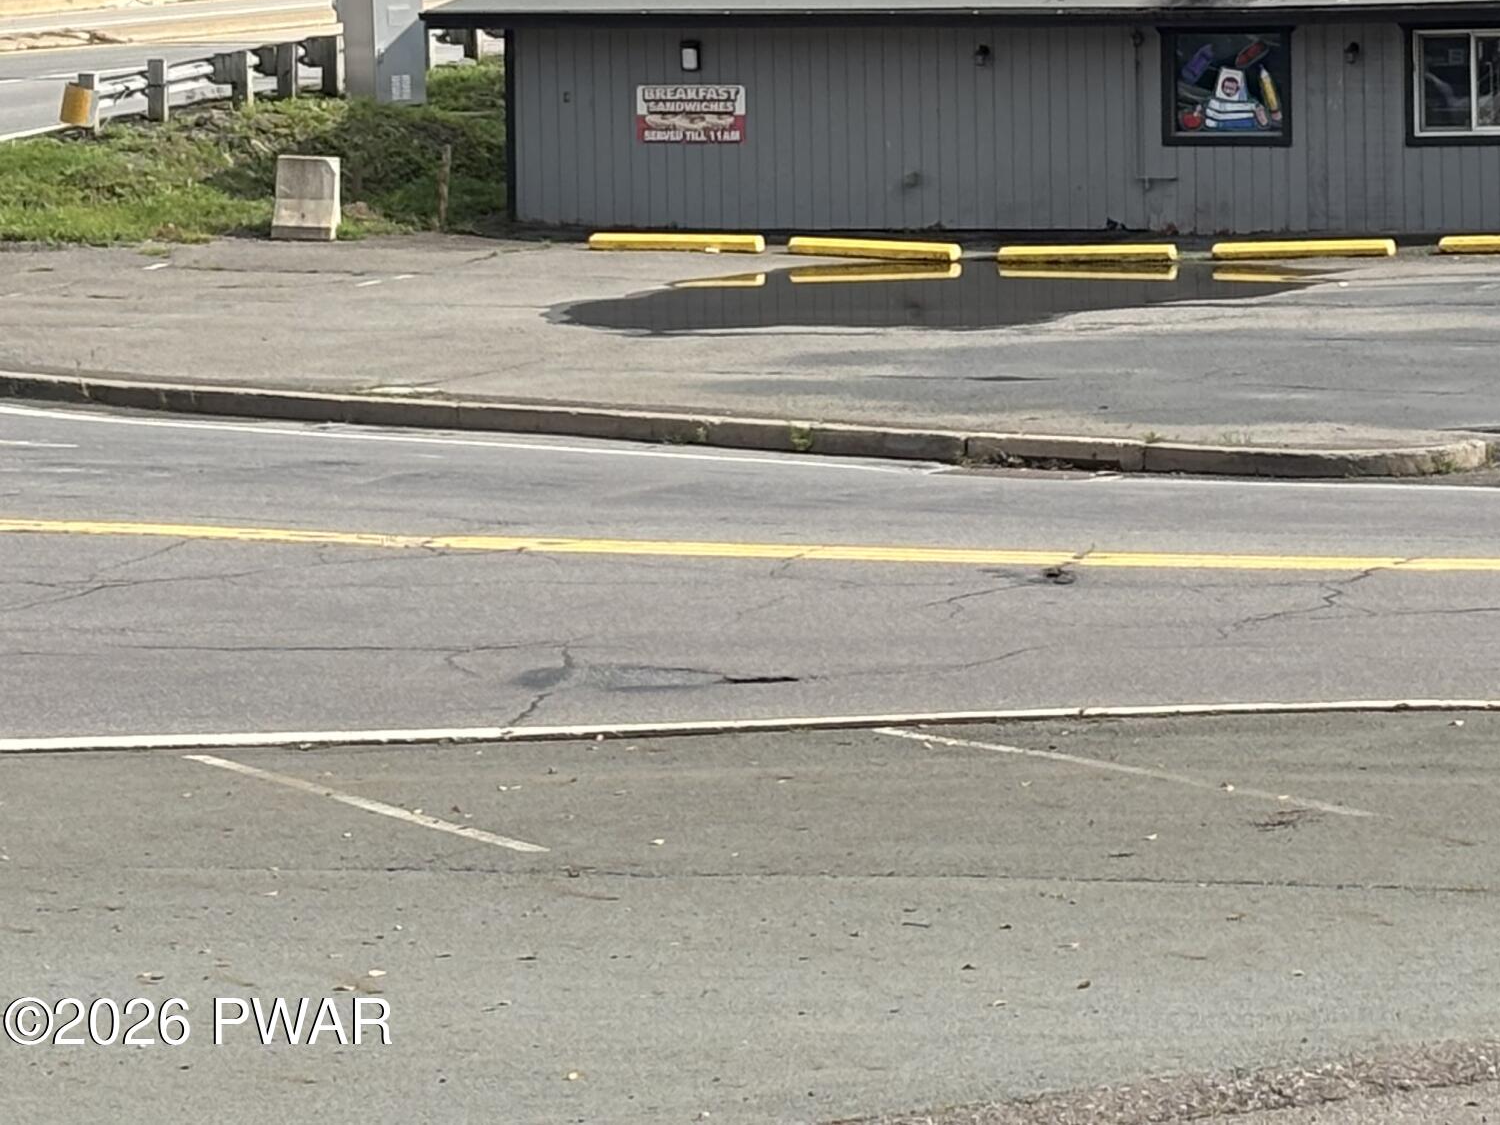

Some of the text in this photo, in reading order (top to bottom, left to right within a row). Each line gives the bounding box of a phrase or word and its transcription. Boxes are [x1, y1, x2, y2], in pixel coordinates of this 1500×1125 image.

[644, 88, 738, 100] BREAKFAST
[649, 101, 734, 112] SANDWICHES
[644, 130, 683, 141] SERVED
[686, 131, 707, 141] TILL
